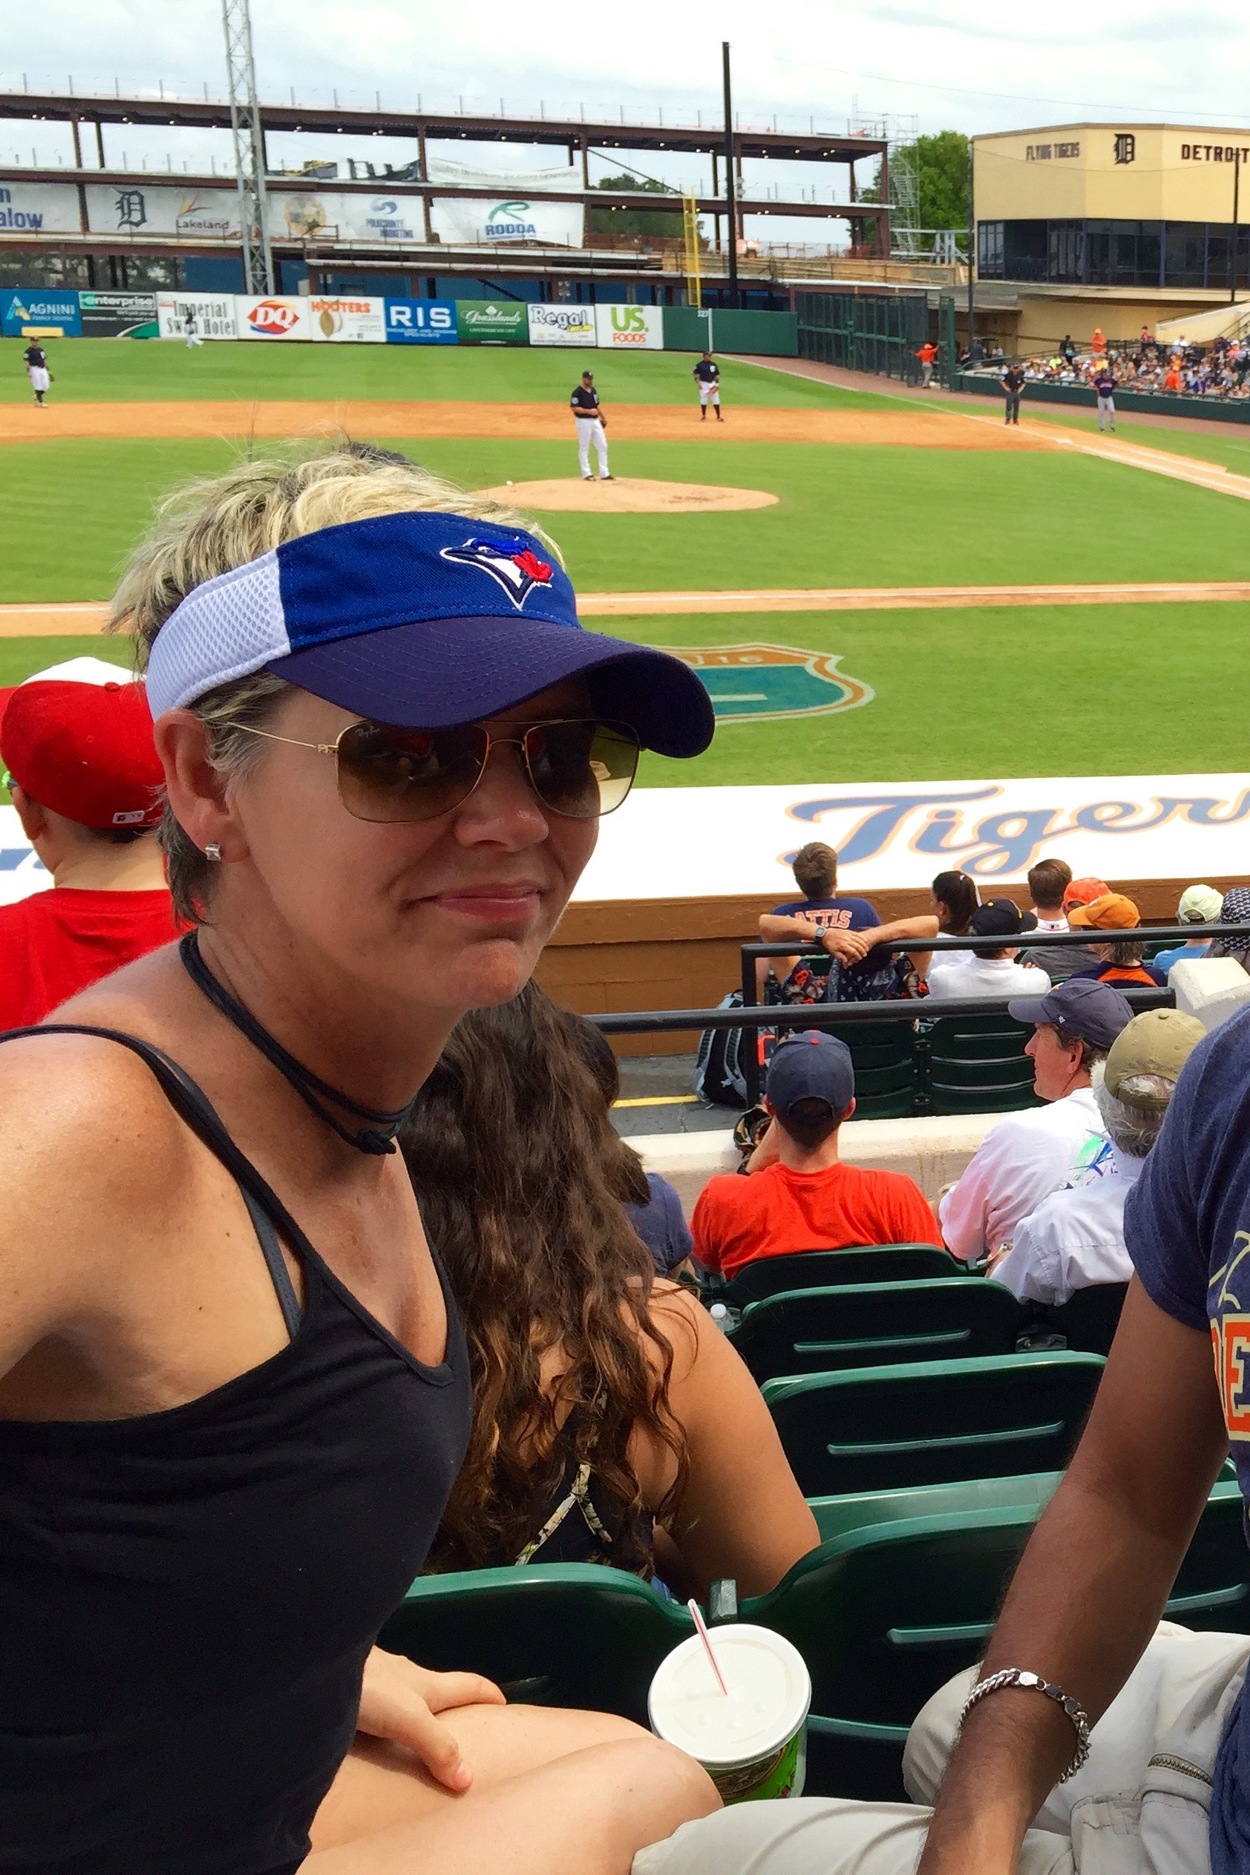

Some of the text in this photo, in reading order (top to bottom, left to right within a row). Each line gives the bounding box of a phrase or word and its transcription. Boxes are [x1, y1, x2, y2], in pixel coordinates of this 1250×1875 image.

[1053, 141, 1080, 159] TIGERS
[1114, 133, 1135, 165] D
[1181, 143, 1250, 166] DETROIT
[113, 187, 148, 230] D
[176, 219, 230, 230] Lakeland
[485, 223, 536, 236] RODDA
[29, 303, 76, 315] AGNINI
[84, 296, 153, 307] enterprise
[173, 300, 227, 318] Imperial
[311, 301, 371, 313] HOOTERS
[253, 305, 294, 329] DQ
[389, 305, 452, 328] RIS
[465, 309, 521, 325] Grasslands
[531, 306, 588, 331] Regal
[203, 319, 236, 335] Hotel
[612, 332, 646, 343] FOODS
[787, 908, 853, 929] ATTIS
